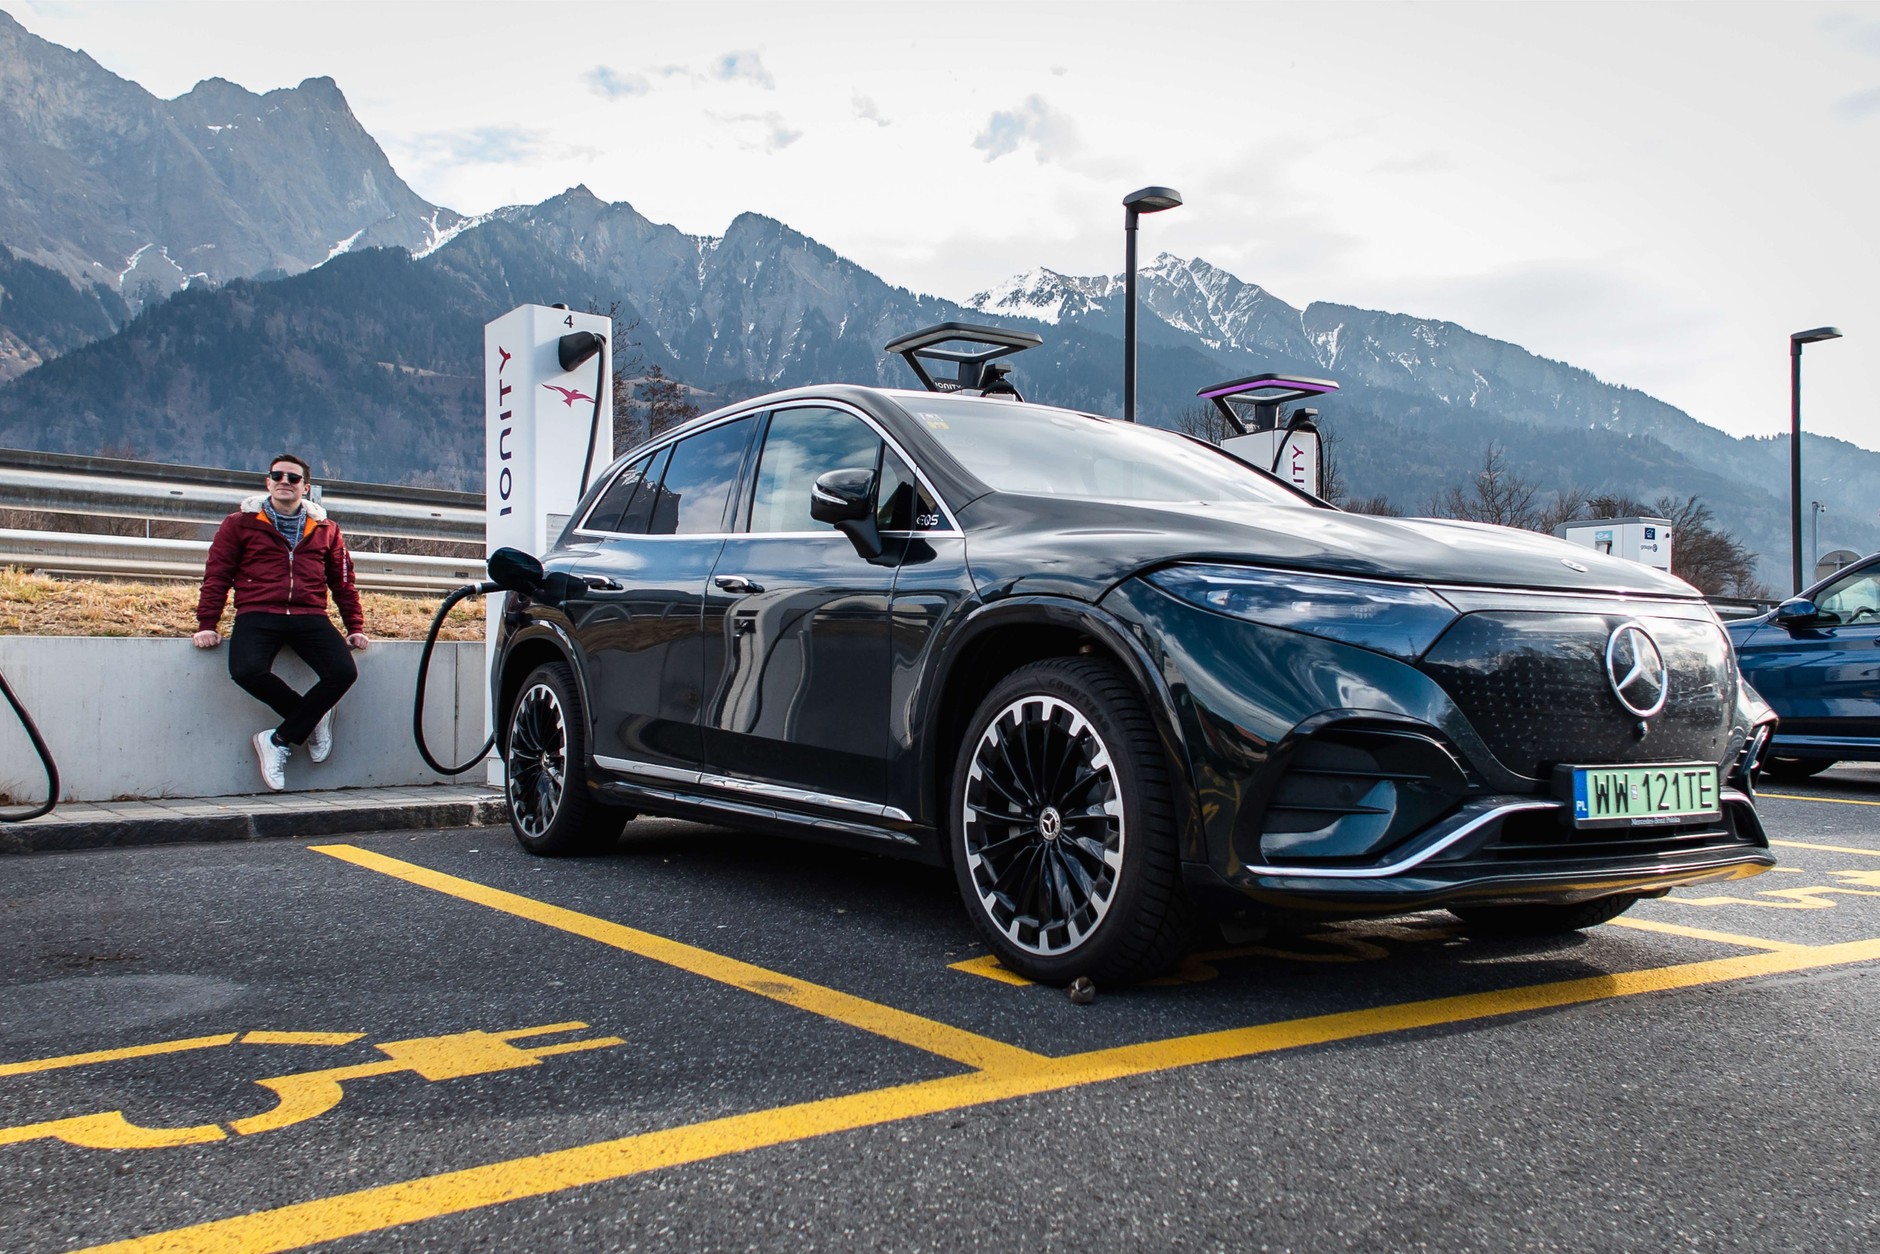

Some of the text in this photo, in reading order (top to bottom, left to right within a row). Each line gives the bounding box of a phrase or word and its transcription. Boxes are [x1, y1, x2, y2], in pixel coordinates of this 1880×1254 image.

[564, 315, 574, 328] 4
[499, 345, 512, 516] IONITY
[916, 514, 939, 526] EQS
[1593, 770, 1712, 814] WW 121TE
[1576, 800, 1587, 811] PL
